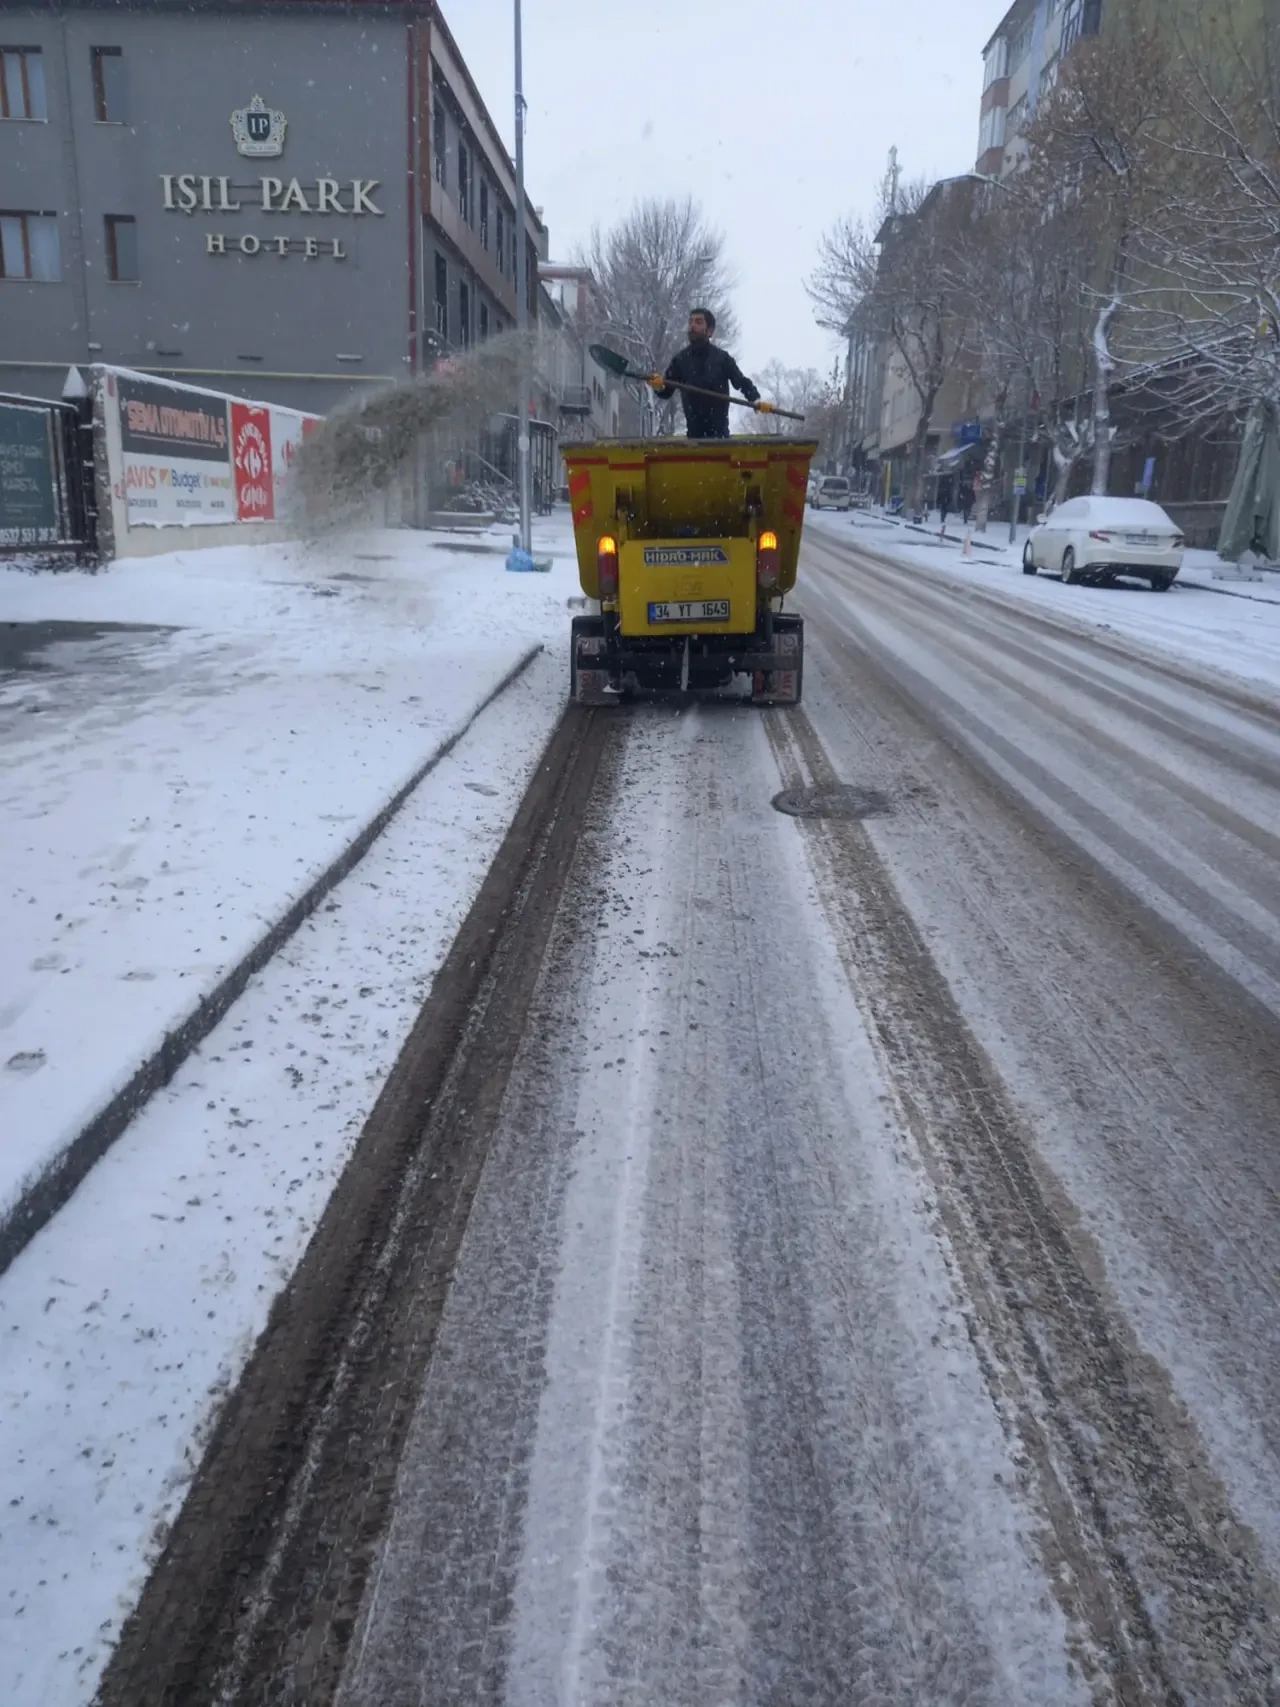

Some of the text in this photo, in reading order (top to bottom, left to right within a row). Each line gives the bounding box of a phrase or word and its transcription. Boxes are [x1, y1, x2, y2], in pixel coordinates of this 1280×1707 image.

[250, 117, 268, 133] IP
[160, 174, 385, 215] IŞIL PARK
[206, 234, 345, 257] HOTEL
[127, 465, 156, 489] AVIS
[656, 602, 728, 618] 34 YT 1649
